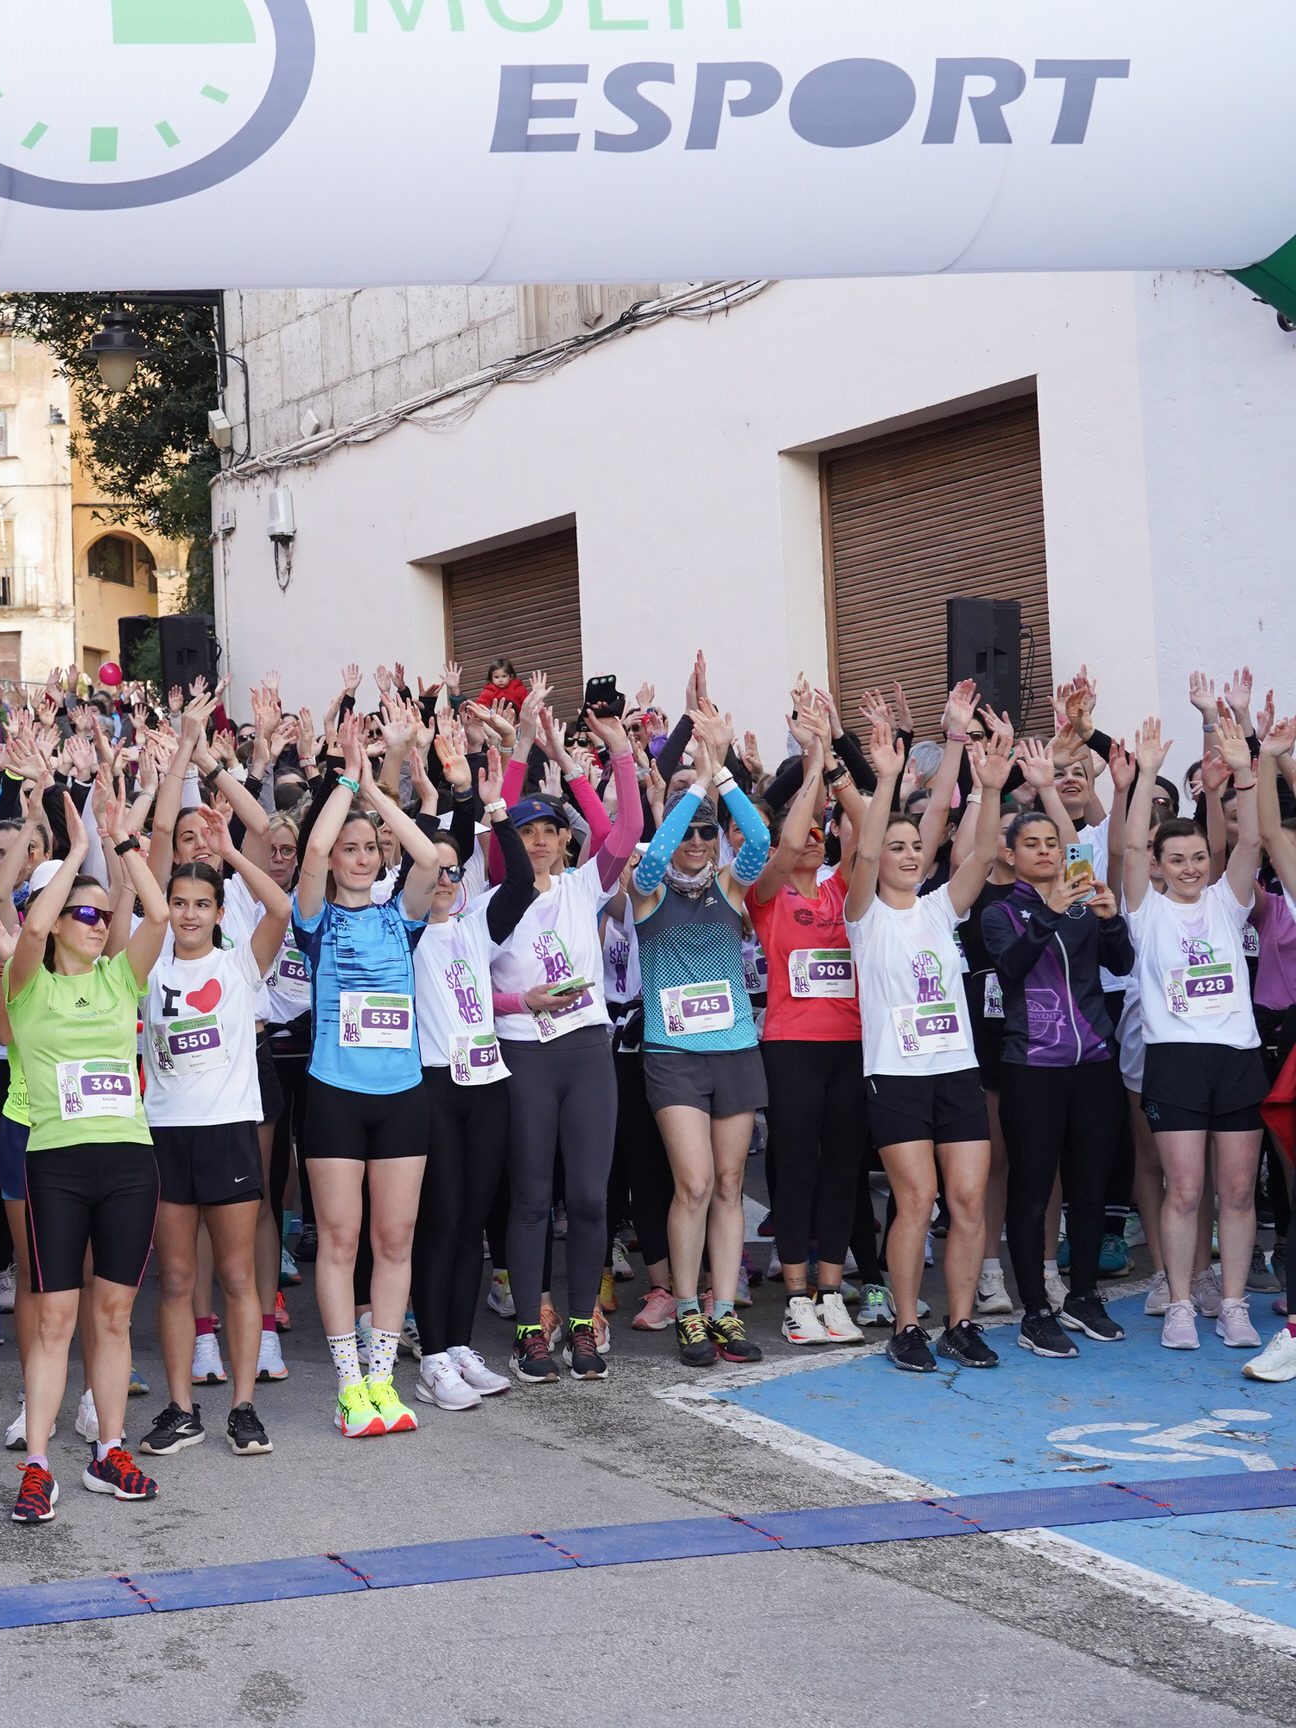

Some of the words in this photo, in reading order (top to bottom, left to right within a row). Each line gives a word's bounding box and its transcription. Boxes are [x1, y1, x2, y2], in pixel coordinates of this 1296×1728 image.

[489, 57, 1130, 153] ESPORT
[817, 965, 845, 976] 906
[1194, 979, 1226, 993] 428
[161, 983, 182, 1016] I
[690, 999, 721, 1013] 745
[370, 1012, 401, 1026] 535
[459, 1004, 483, 1024] NES
[926, 1018, 950, 1031] 427
[177, 1033, 210, 1050] 550
[90, 1078, 123, 1091] 364
